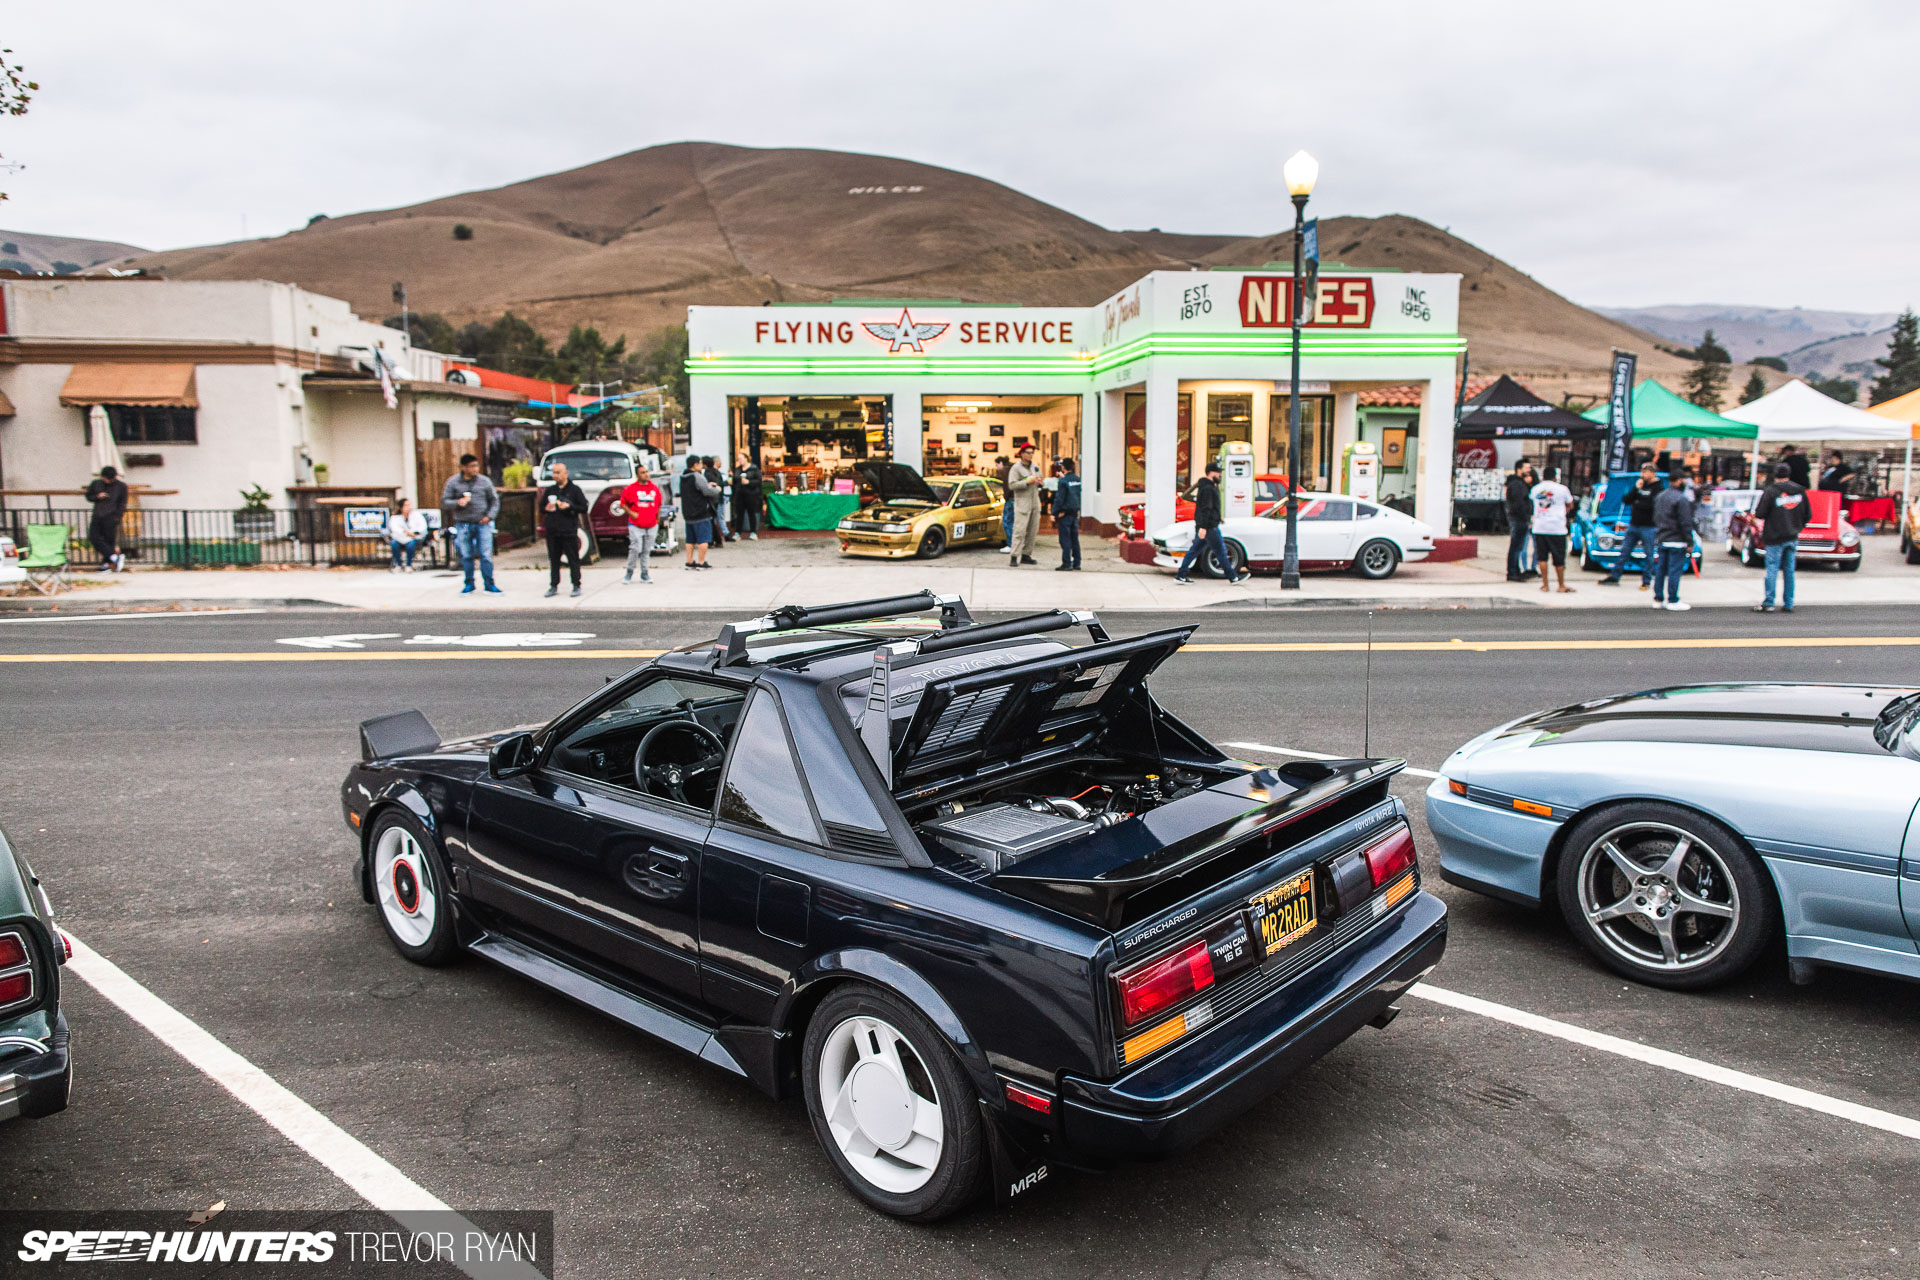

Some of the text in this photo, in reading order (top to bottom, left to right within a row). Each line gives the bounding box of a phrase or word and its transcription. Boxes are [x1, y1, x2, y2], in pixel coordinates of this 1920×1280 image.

[1181, 299, 1212, 320] 1870
[1247, 281, 1367, 324] NIES
[1401, 300, 1431, 322] 1956
[756, 321, 854, 343] FLYING
[960, 321, 1073, 343] SERVICE
[1354, 805, 1393, 831] TOYOTA MR2
[1123, 907, 1198, 949] SUPERCHARGED
[1261, 896, 1309, 945] MR2RAD
[1213, 934, 1248, 957] TWIN CAM
[1223, 953, 1234, 963] 16
[1010, 1165, 1048, 1197] MR2
